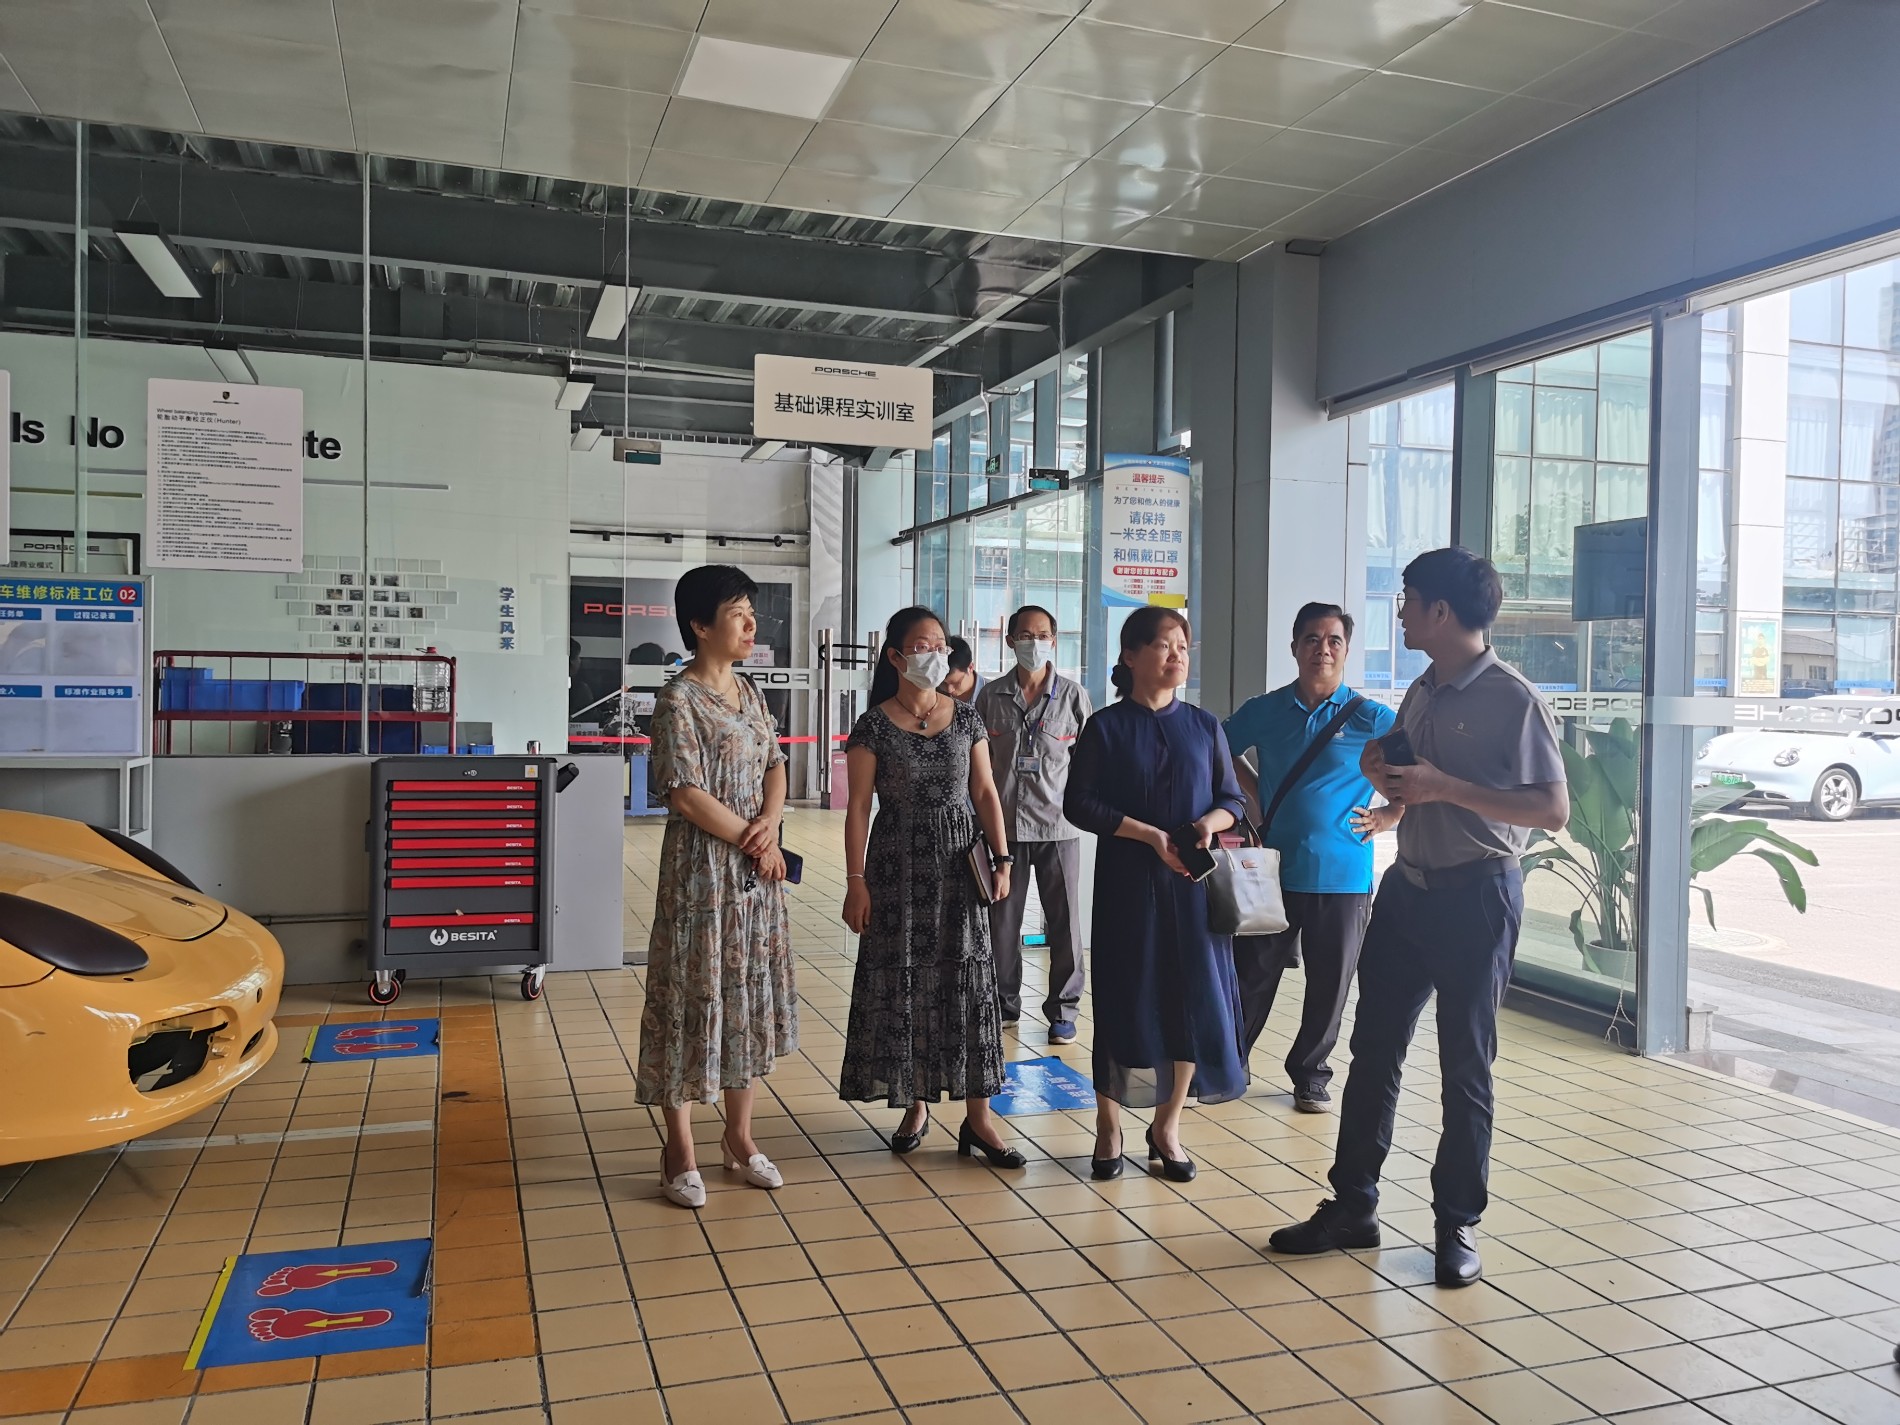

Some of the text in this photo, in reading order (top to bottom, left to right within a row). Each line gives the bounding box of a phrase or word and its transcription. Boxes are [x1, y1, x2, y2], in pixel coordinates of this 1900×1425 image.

[814, 366, 877, 378] PORSCHE
[774, 392, 915, 422] 基础课程实训室
[70, 414, 125, 449] No
[1132, 472, 1165, 484] 温馨提示
[1113, 495, 1181, 508] 为了您和他人的健康
[1129, 511, 1166, 526] 请保持
[1110, 527, 1182, 543] 一米安全距离
[23, 543, 100, 552] PORSCE
[1113, 547, 1178, 564] 和佩戴口罩
[1116, 566, 1174, 577] 谢谢您的理解与配合
[119, 589, 136, 600] 02
[499, 586, 516, 650] 学生风采
[450, 930, 497, 942] BESITA
